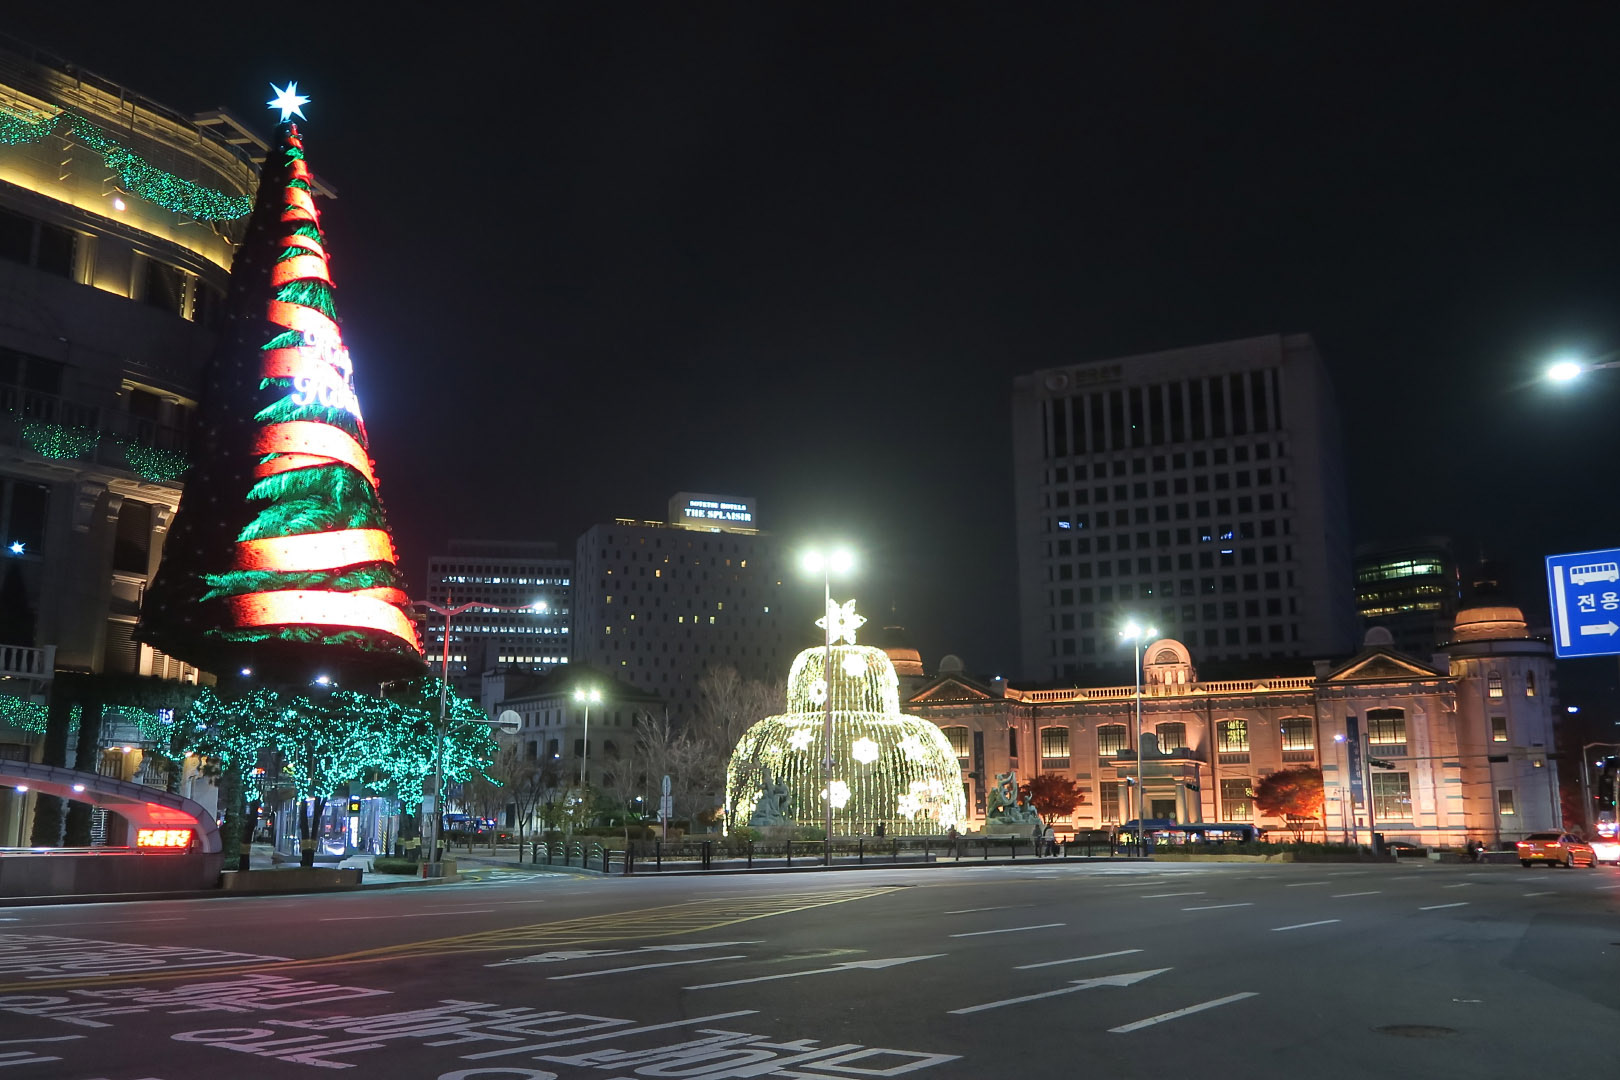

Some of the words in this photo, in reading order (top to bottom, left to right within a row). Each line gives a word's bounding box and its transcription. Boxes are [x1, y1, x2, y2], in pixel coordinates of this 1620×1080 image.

[684, 508, 705, 518] THE
[707, 510, 752, 521] SPLAISIR
[1577, 591, 1620, 613] 전용
[171, 999, 637, 1069] 광화문
